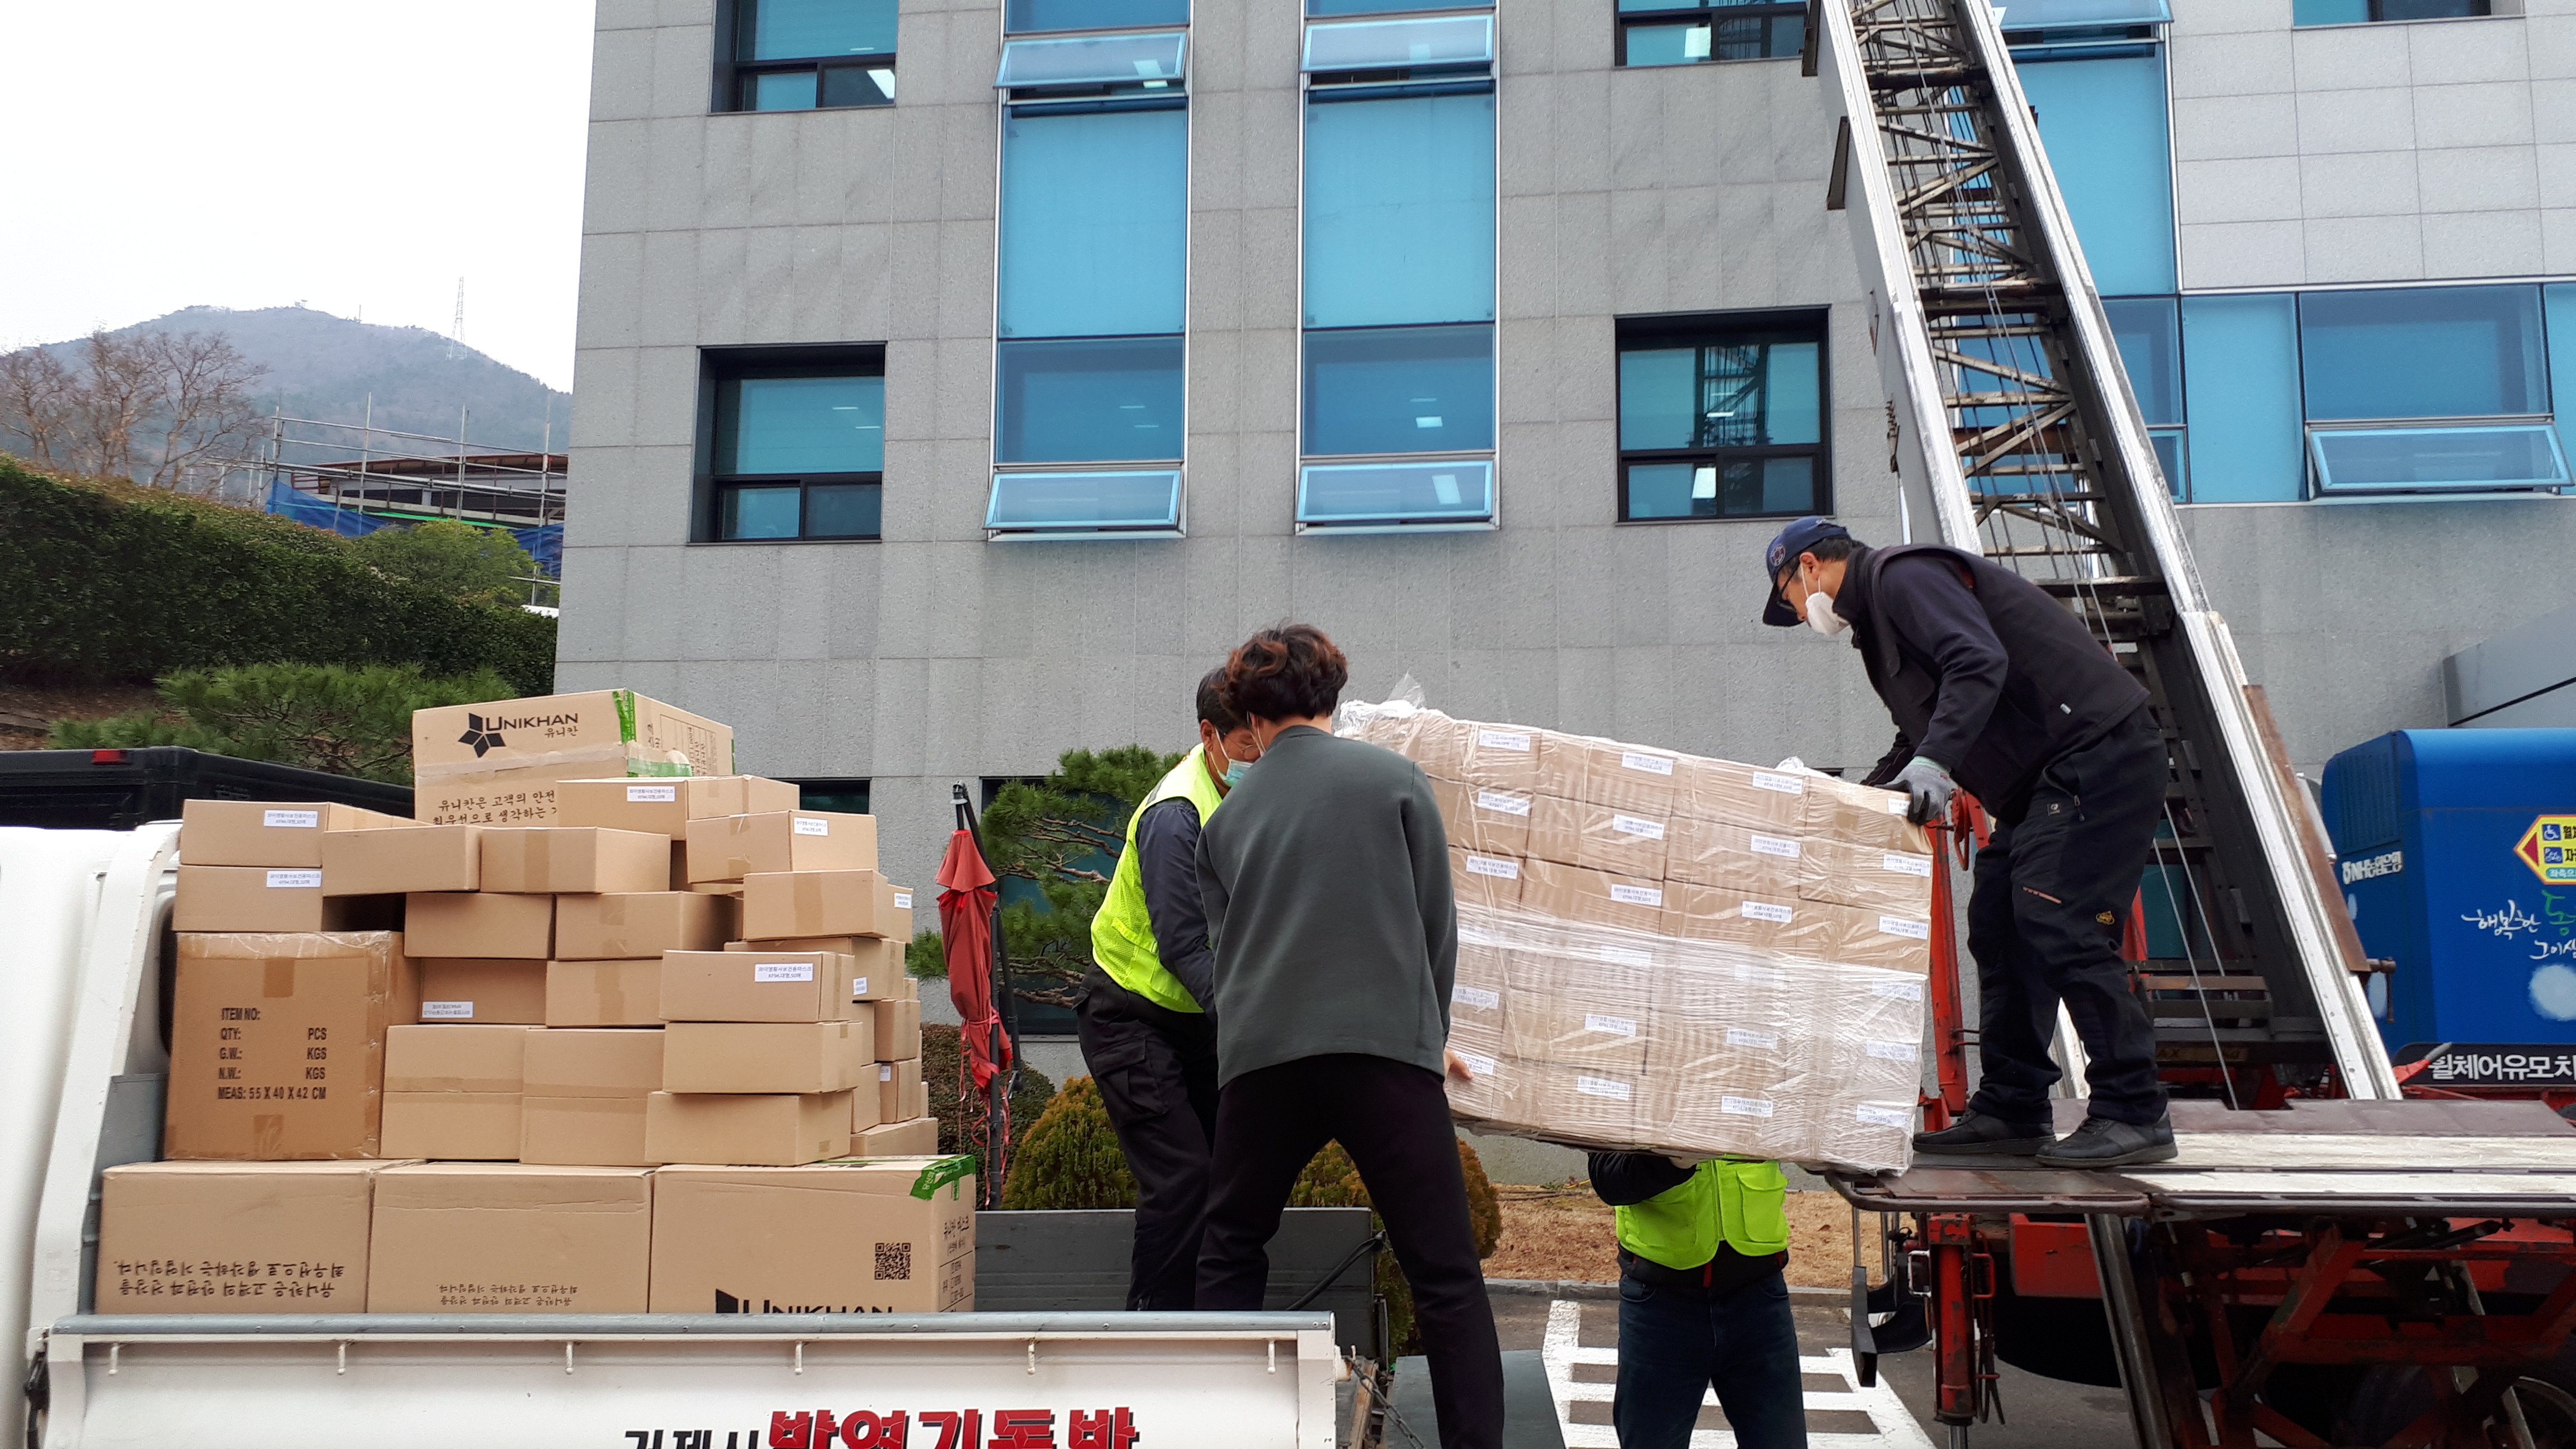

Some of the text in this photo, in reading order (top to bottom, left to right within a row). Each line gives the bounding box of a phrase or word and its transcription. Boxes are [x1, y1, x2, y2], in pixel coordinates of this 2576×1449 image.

[486, 713, 578, 731] UNIKHAN
[544, 726, 578, 738] 유니칸
[439, 790, 555, 812] 유니칸은 고객의 안전
[499, 807, 546, 823] 생각하는
[2461, 899, 2541, 940] 행복한
[221, 1007, 261, 1021] ITEM NO:
[221, 1027, 327, 1040] QTY: PCS
[306, 1047, 327, 1060] KGS
[306, 1067, 325, 1079] KGS
[218, 1086, 246, 1100] MEAS:
[263, 1086, 271, 1100] X
[287, 1086, 294, 1100] X
[312, 1086, 326, 1100] CM
[200, 1261, 261, 1278] 생각하는
[266, 1261, 344, 1279] 최우선으로
[170, 1280, 215, 1297] 안전과
[222, 1281, 267, 1297] 고객의
[273, 1281, 335, 1299] 유니칸은
